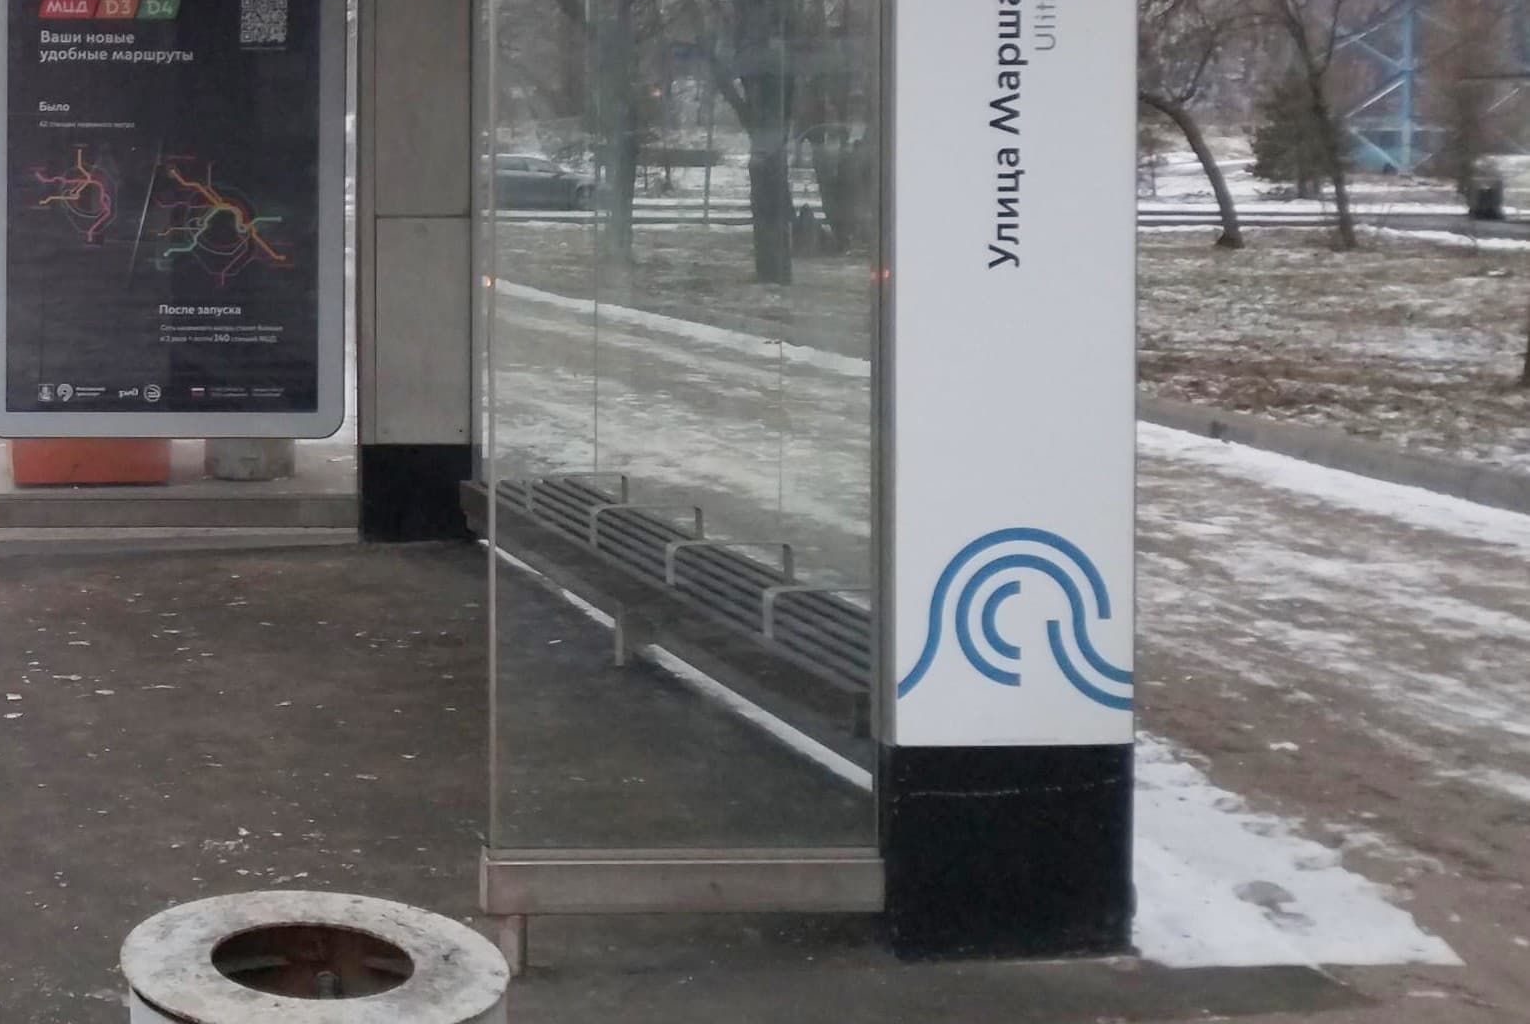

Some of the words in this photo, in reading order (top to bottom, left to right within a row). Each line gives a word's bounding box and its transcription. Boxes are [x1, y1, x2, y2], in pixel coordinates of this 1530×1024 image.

[46, 0, 88, 13] МЦД
[105, 0, 131, 14] D3
[147, 0, 173, 14] D4
[40, 30, 82, 44] Ваши
[86, 32, 135, 44] новые
[39, 47, 108, 63] удобные
[111, 50, 194, 64] маршруты
[39, 101, 70, 112] Было
[988, 146, 1026, 269] Улица
[158, 304, 195, 315] После
[197, 306, 241, 317] запуска
